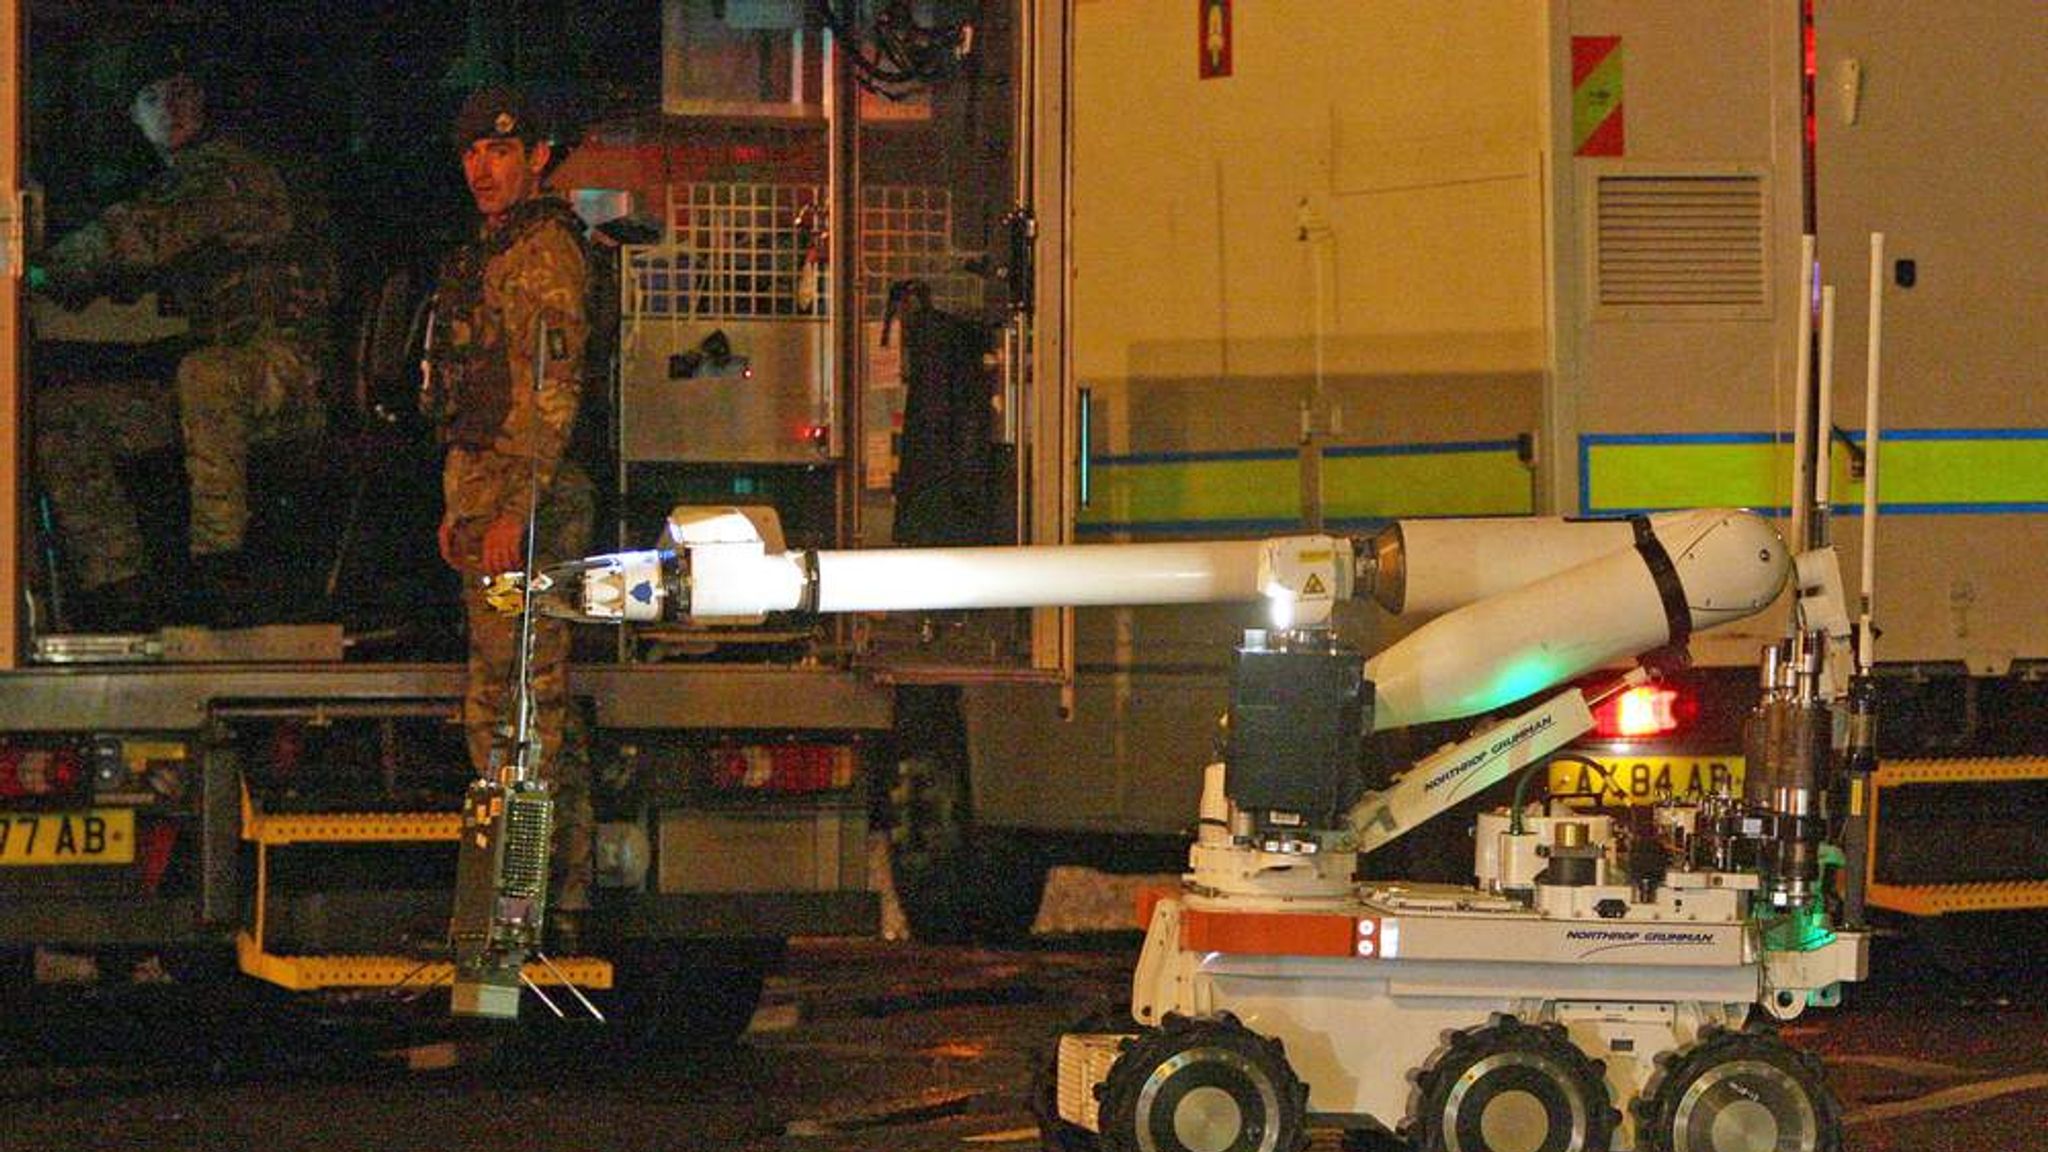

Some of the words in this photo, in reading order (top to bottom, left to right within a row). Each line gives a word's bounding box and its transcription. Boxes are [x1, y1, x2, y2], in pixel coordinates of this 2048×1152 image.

[1424, 751, 1487, 793] NORTHROP
[1491, 714, 1552, 755] GRUMMAN
[1632, 763, 1673, 797] 84
[55, 816, 106, 855] AB
[1567, 930, 1639, 941] NORTHROP
[1644, 931, 1713, 943] GRUMMAN
